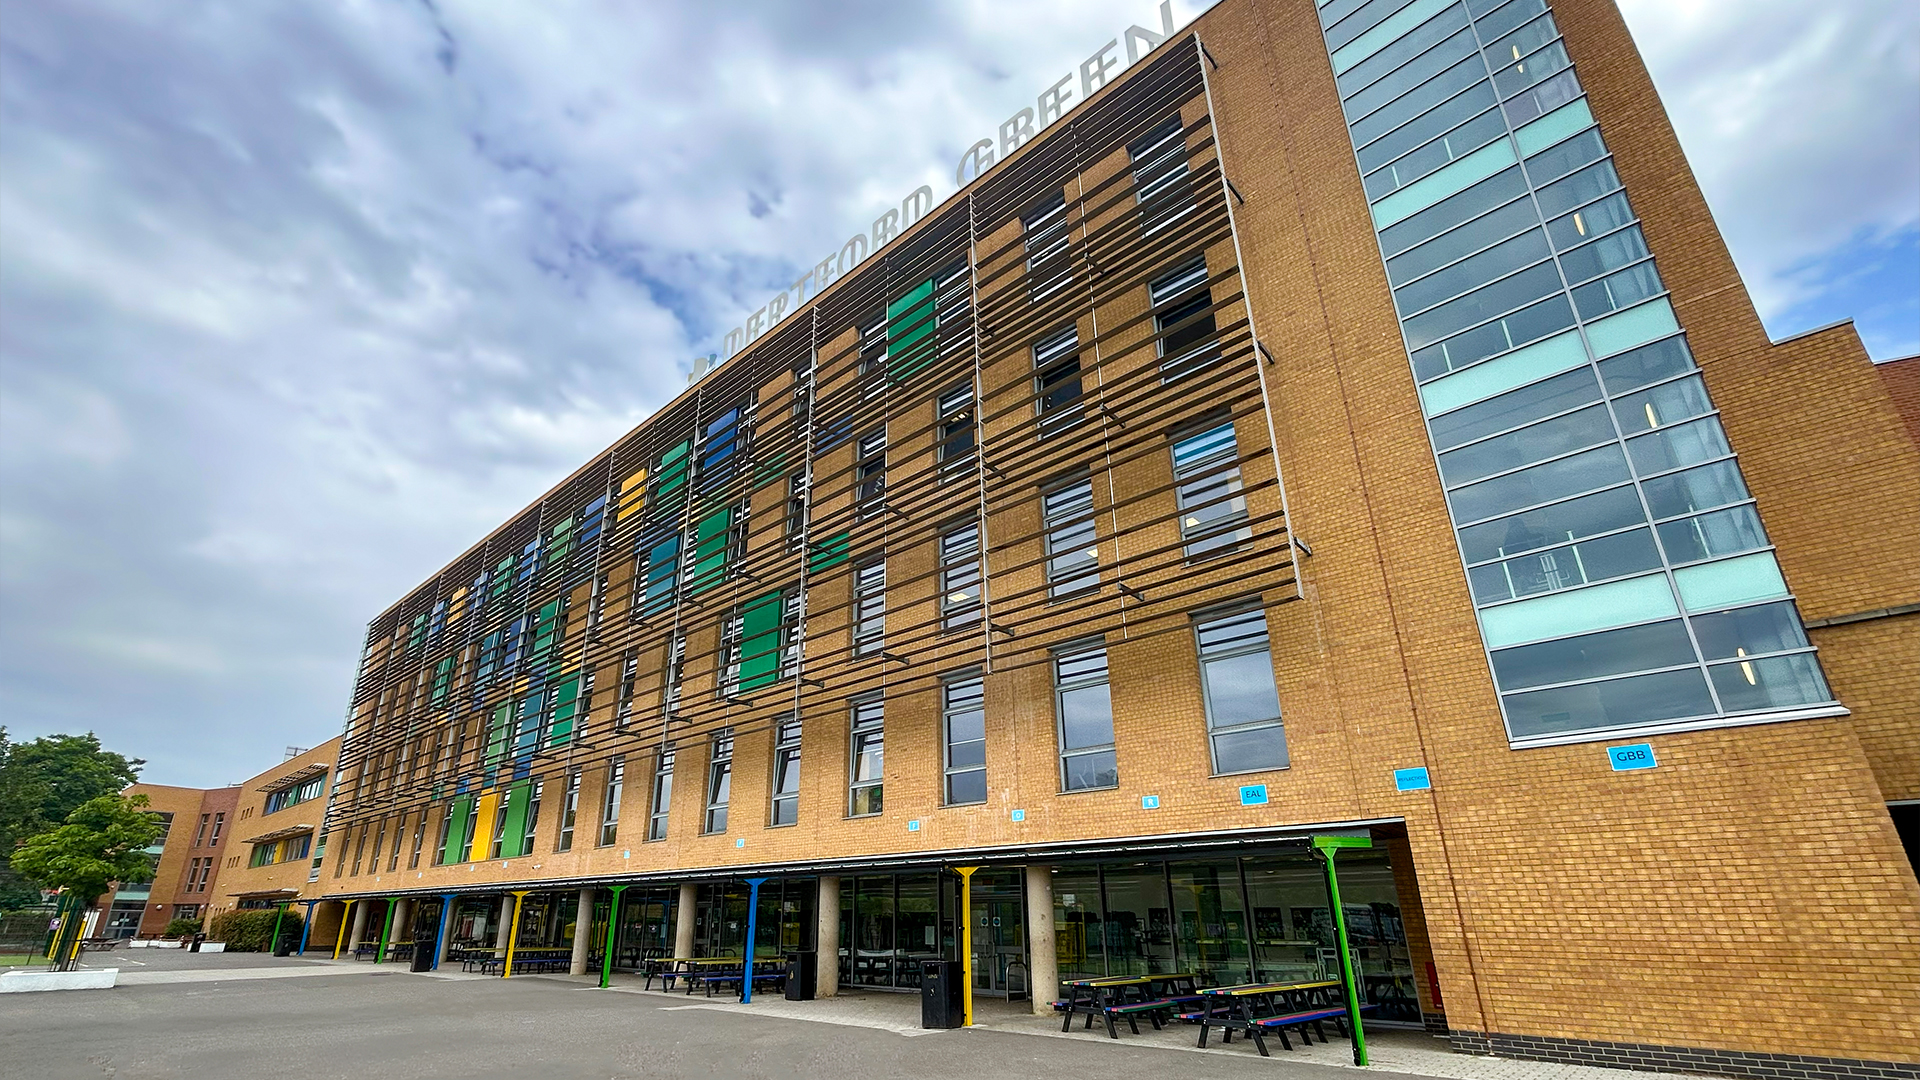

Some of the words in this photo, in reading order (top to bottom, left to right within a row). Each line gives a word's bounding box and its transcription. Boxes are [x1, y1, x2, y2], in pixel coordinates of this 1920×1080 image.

[956, 0, 1174, 189] GREEN
[1616, 750, 1646, 762] GBB
[1245, 790, 1261, 798] EAL
[1147, 798, 1154, 806] R
